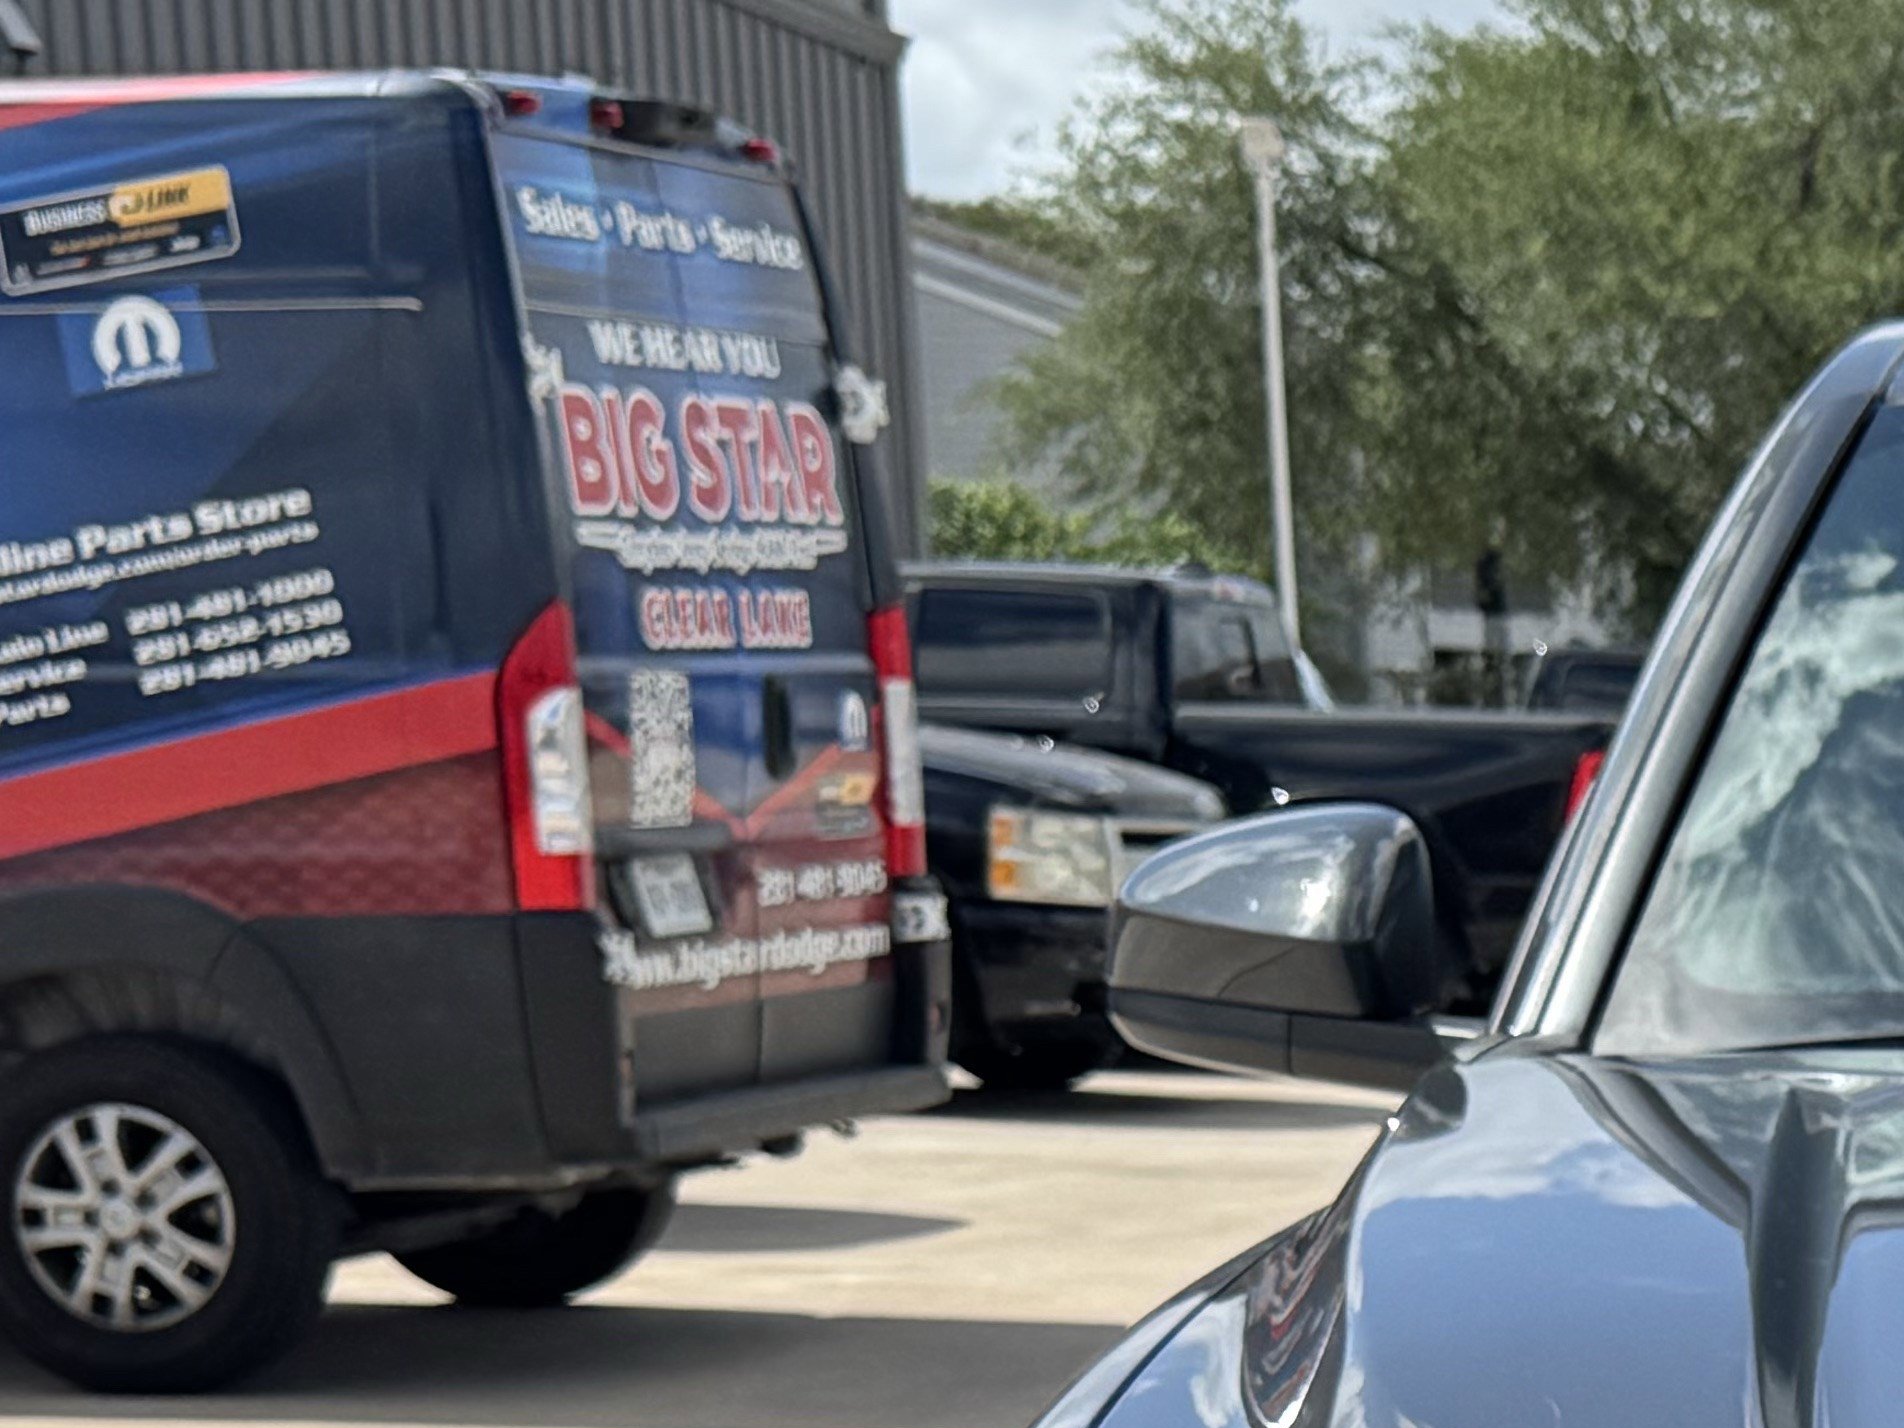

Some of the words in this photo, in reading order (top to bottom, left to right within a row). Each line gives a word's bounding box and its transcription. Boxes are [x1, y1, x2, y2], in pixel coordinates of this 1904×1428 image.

[516, 186, 599, 241] Sales
[614, 200, 697, 254] Parts
[706, 215, 803, 270] Service
[587, 320, 643, 366] WE
[641, 324, 724, 374] HEAR
[721, 333, 782, 380] YOU
[557, 382, 680, 521] BIG
[680, 391, 845, 527] STAR
[74, 513, 194, 560] Parts
[192, 487, 313, 535] Store
[642, 586, 737, 650] CLEAR
[738, 587, 813, 649] LAKE
